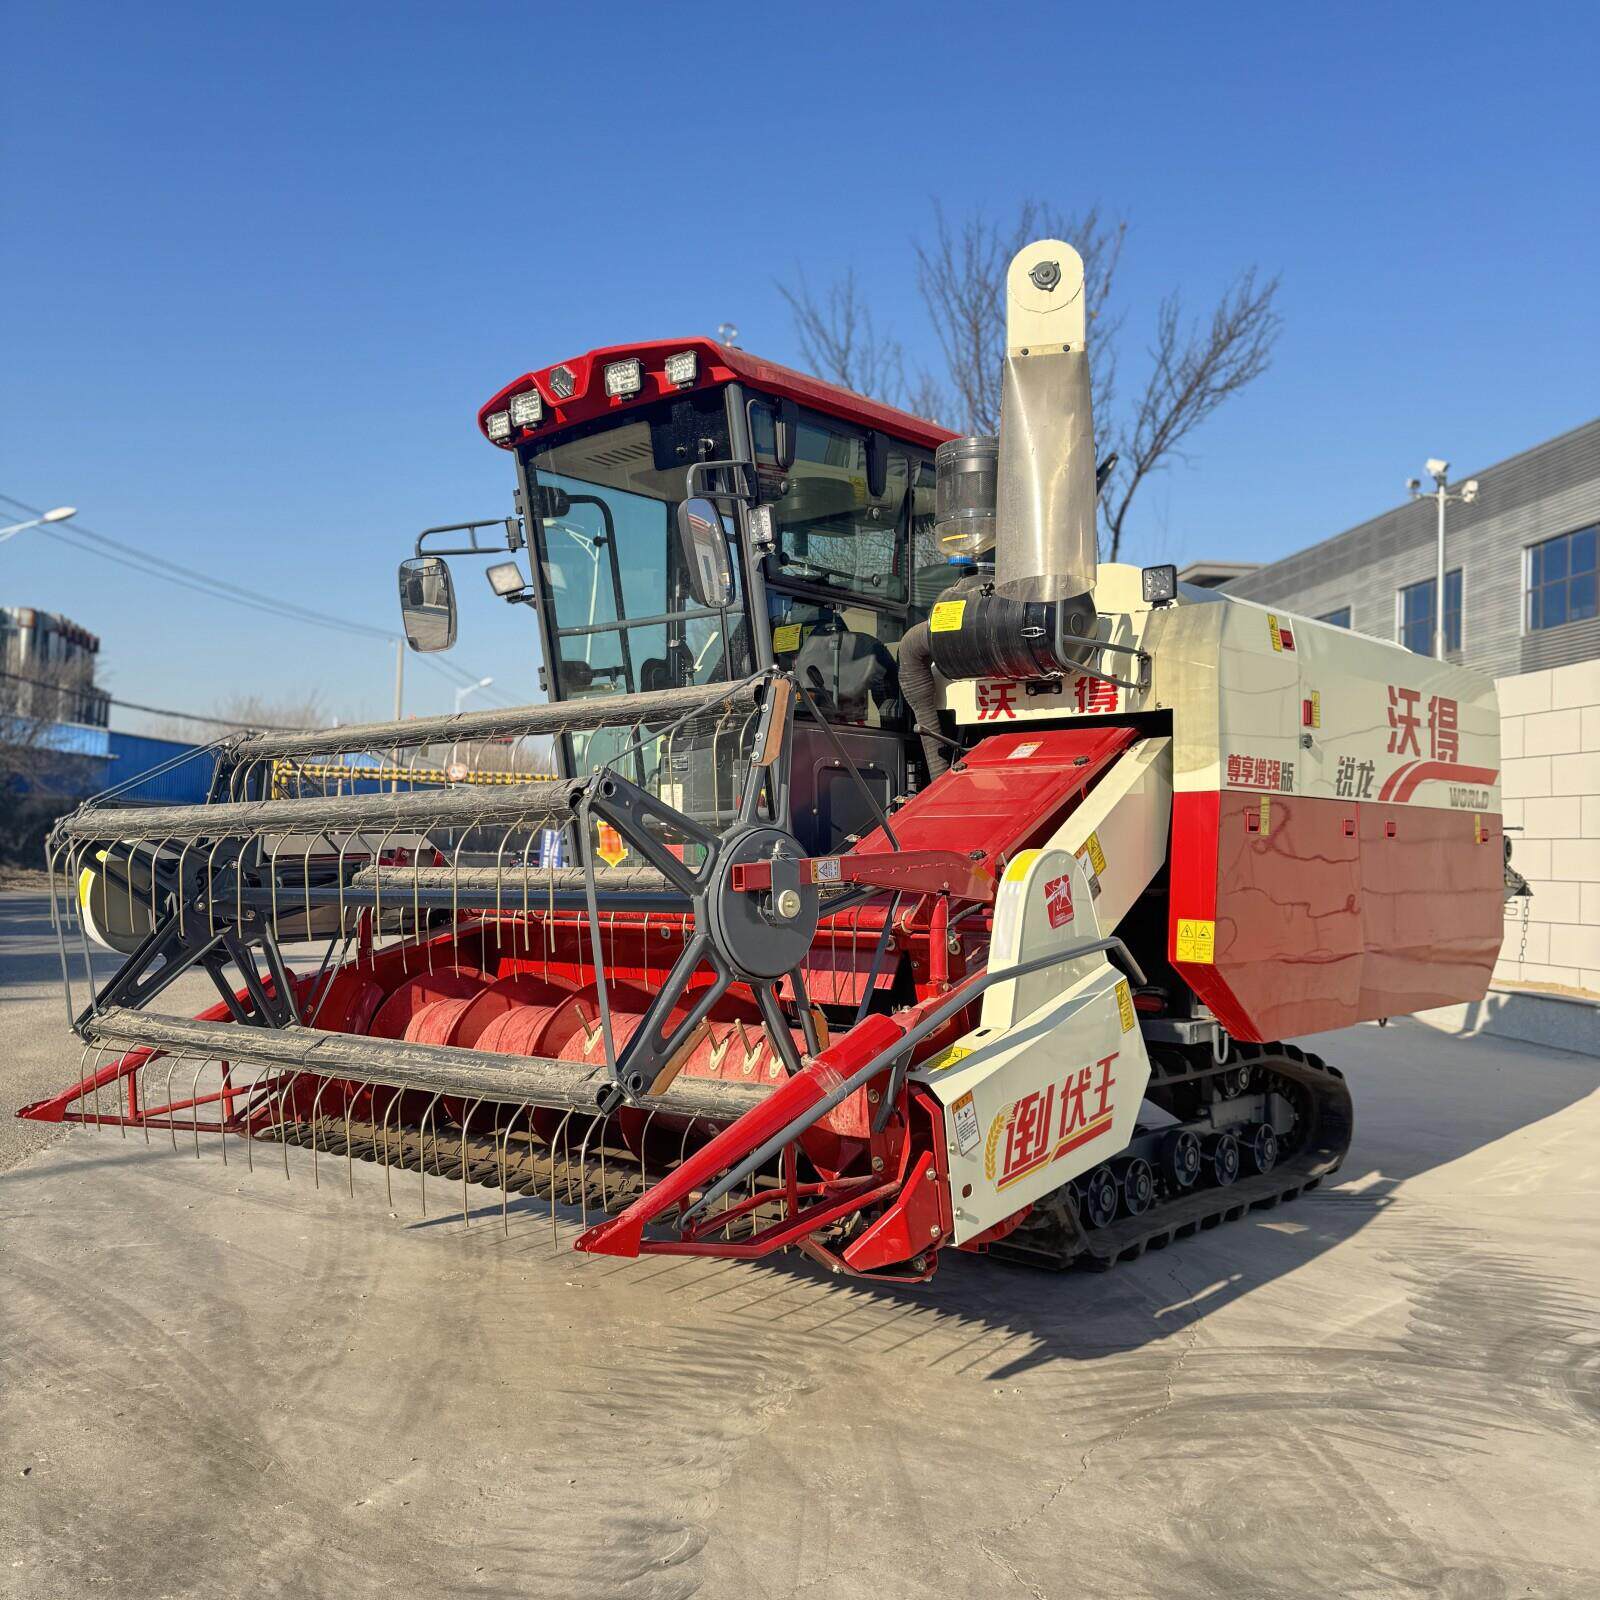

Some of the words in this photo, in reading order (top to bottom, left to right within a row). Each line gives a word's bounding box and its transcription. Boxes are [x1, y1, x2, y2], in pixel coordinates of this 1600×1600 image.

[1387, 685, 1459, 763] 沃得
[1227, 754, 1294, 792] 尊享增强版
[1336, 756, 1375, 799] 锐龙
[1450, 787, 1490, 810] WORLD
[1003, 1051, 1120, 1176] 倒伏王
